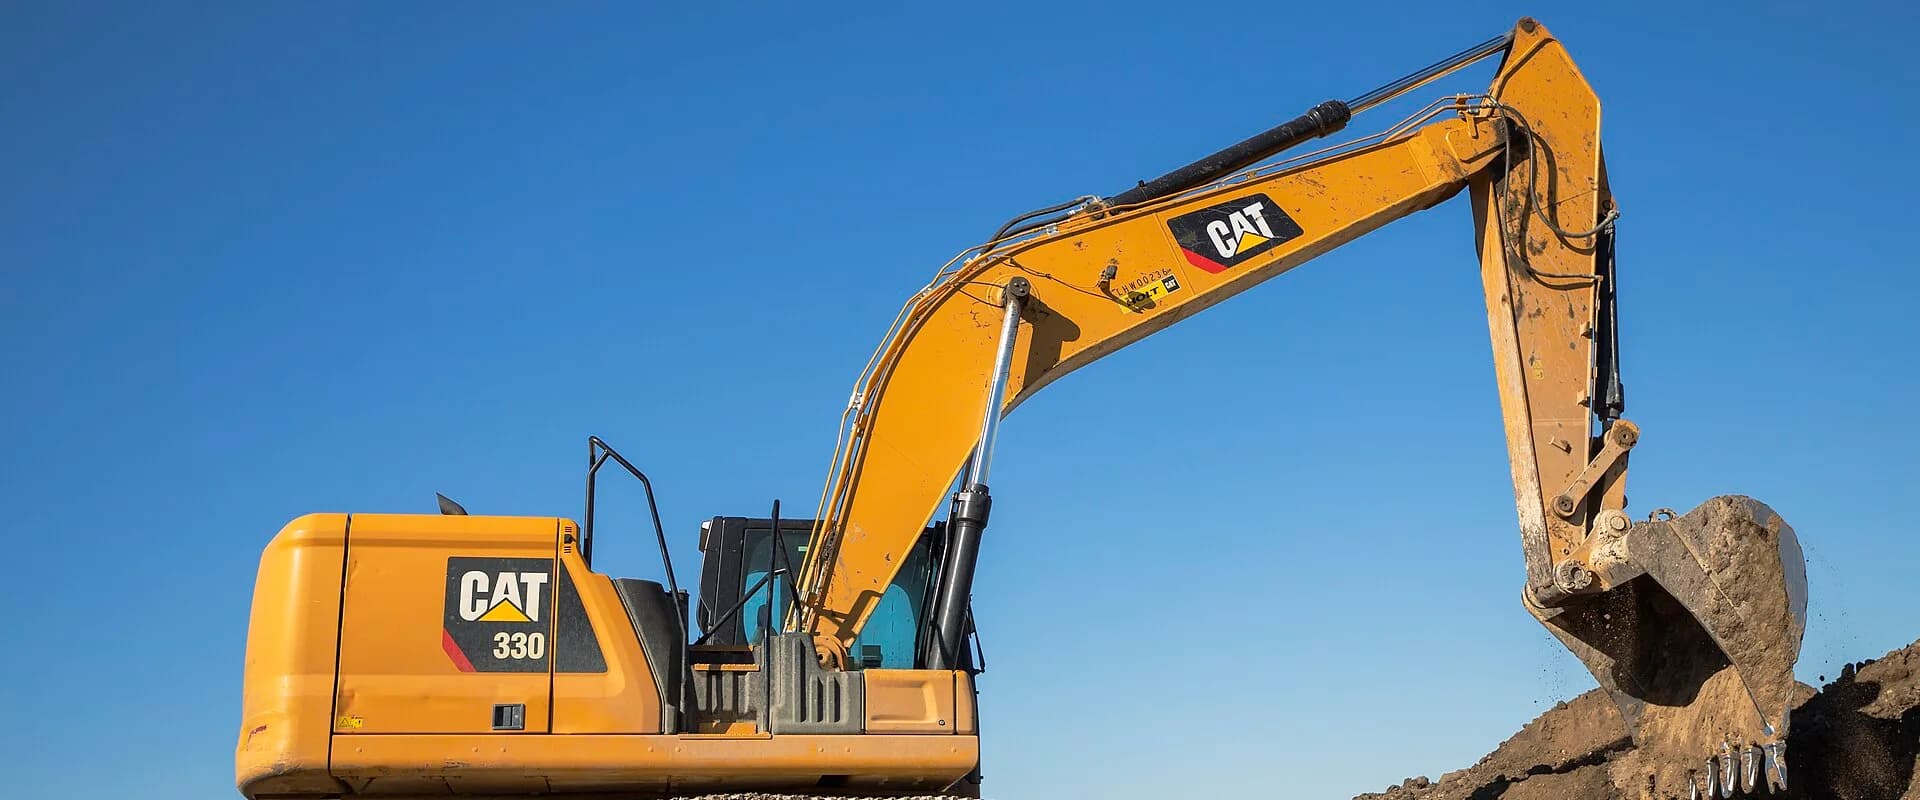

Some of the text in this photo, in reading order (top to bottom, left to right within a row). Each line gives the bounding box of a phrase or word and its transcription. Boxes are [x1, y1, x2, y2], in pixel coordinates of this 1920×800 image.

[1207, 201, 1274, 258] CAT
[1164, 280, 1176, 289] CAT
[459, 571, 548, 622] CAT
[493, 632, 545, 660] 330
